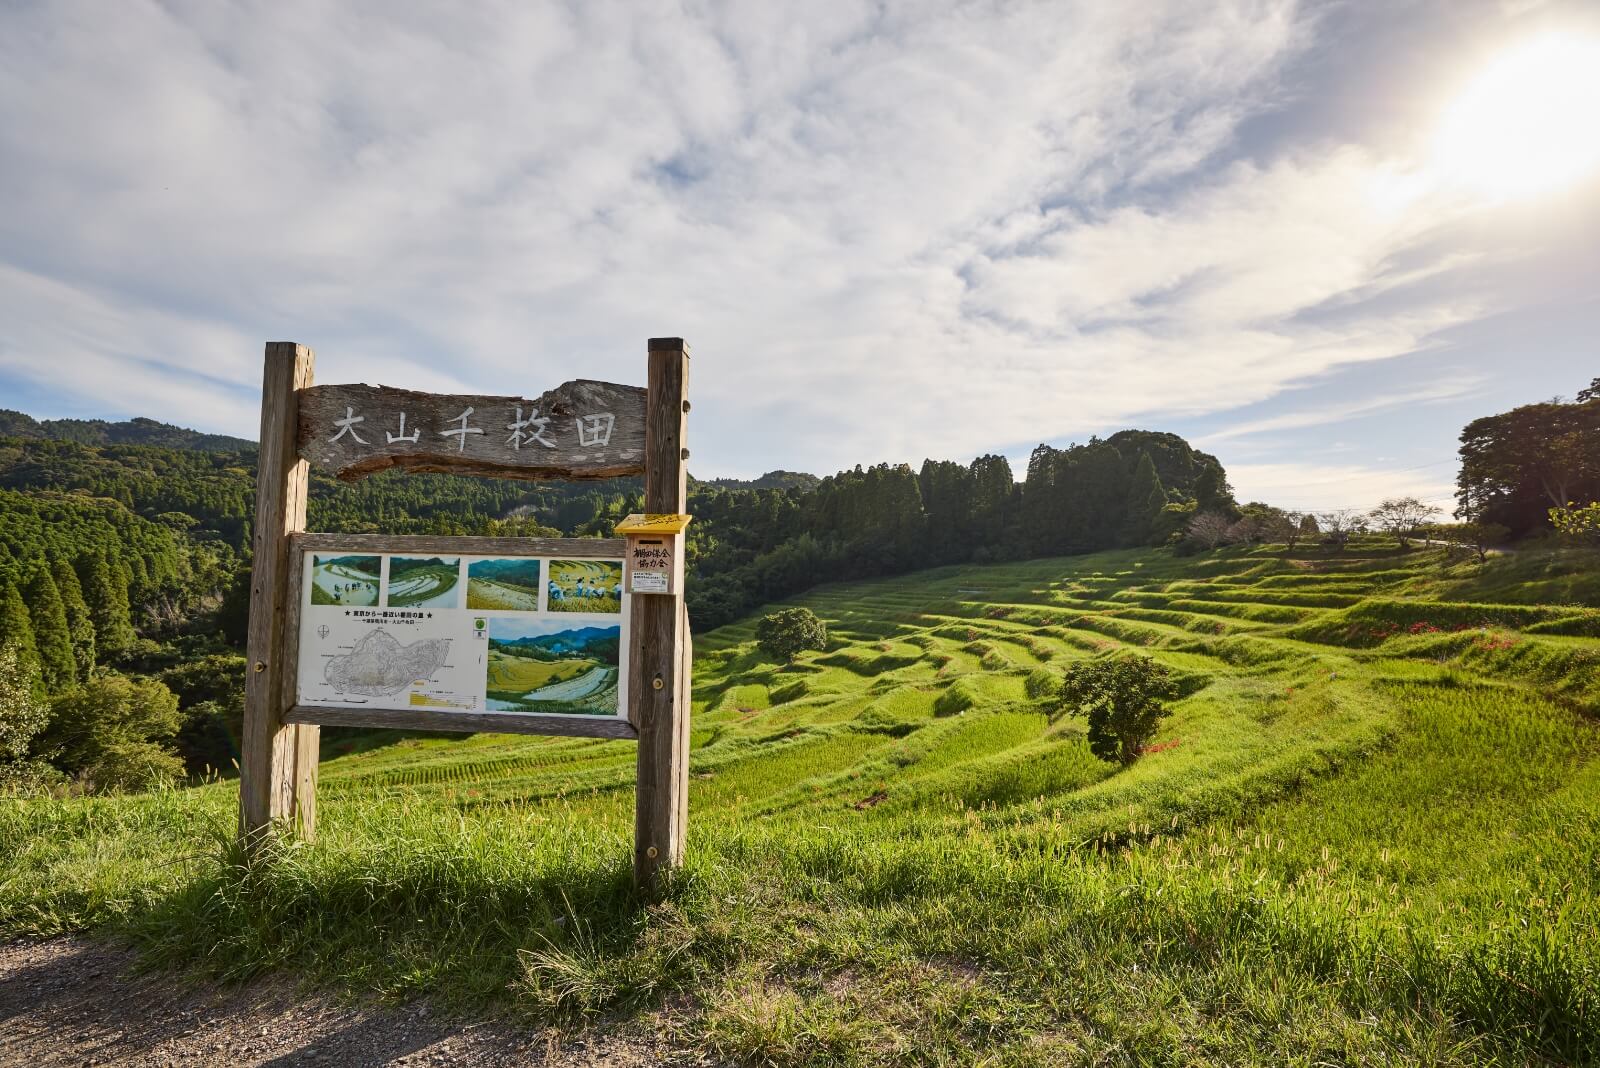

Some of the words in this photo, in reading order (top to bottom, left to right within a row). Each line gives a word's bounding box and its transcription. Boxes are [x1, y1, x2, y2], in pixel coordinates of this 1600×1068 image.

[328, 406, 616, 452] 大山千枚田
